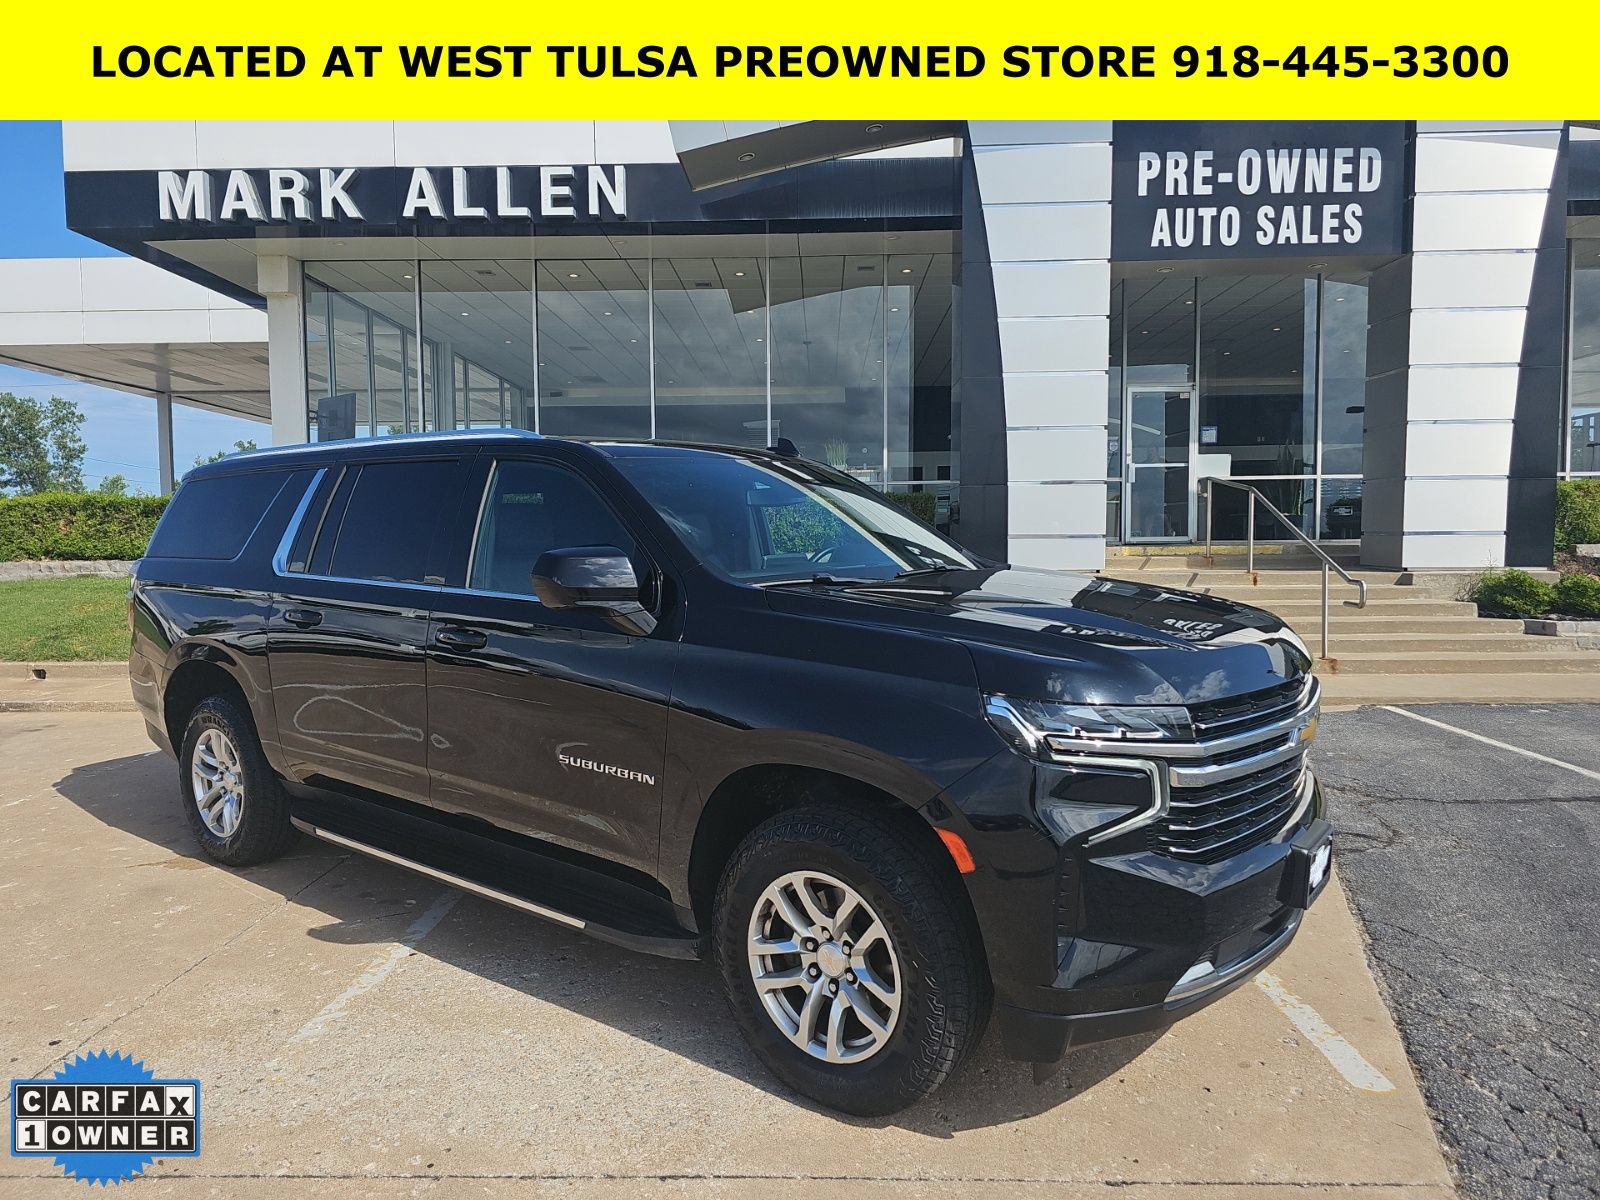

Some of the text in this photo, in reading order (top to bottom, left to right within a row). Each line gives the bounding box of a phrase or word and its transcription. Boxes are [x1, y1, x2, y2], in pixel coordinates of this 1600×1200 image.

[158, 165, 627, 222] MARK ALLEN
[1138, 147, 1382, 196] PRE-OWNED
[1151, 203, 1363, 247] AUTO SALES
[559, 754, 655, 785] SUBURBAN
